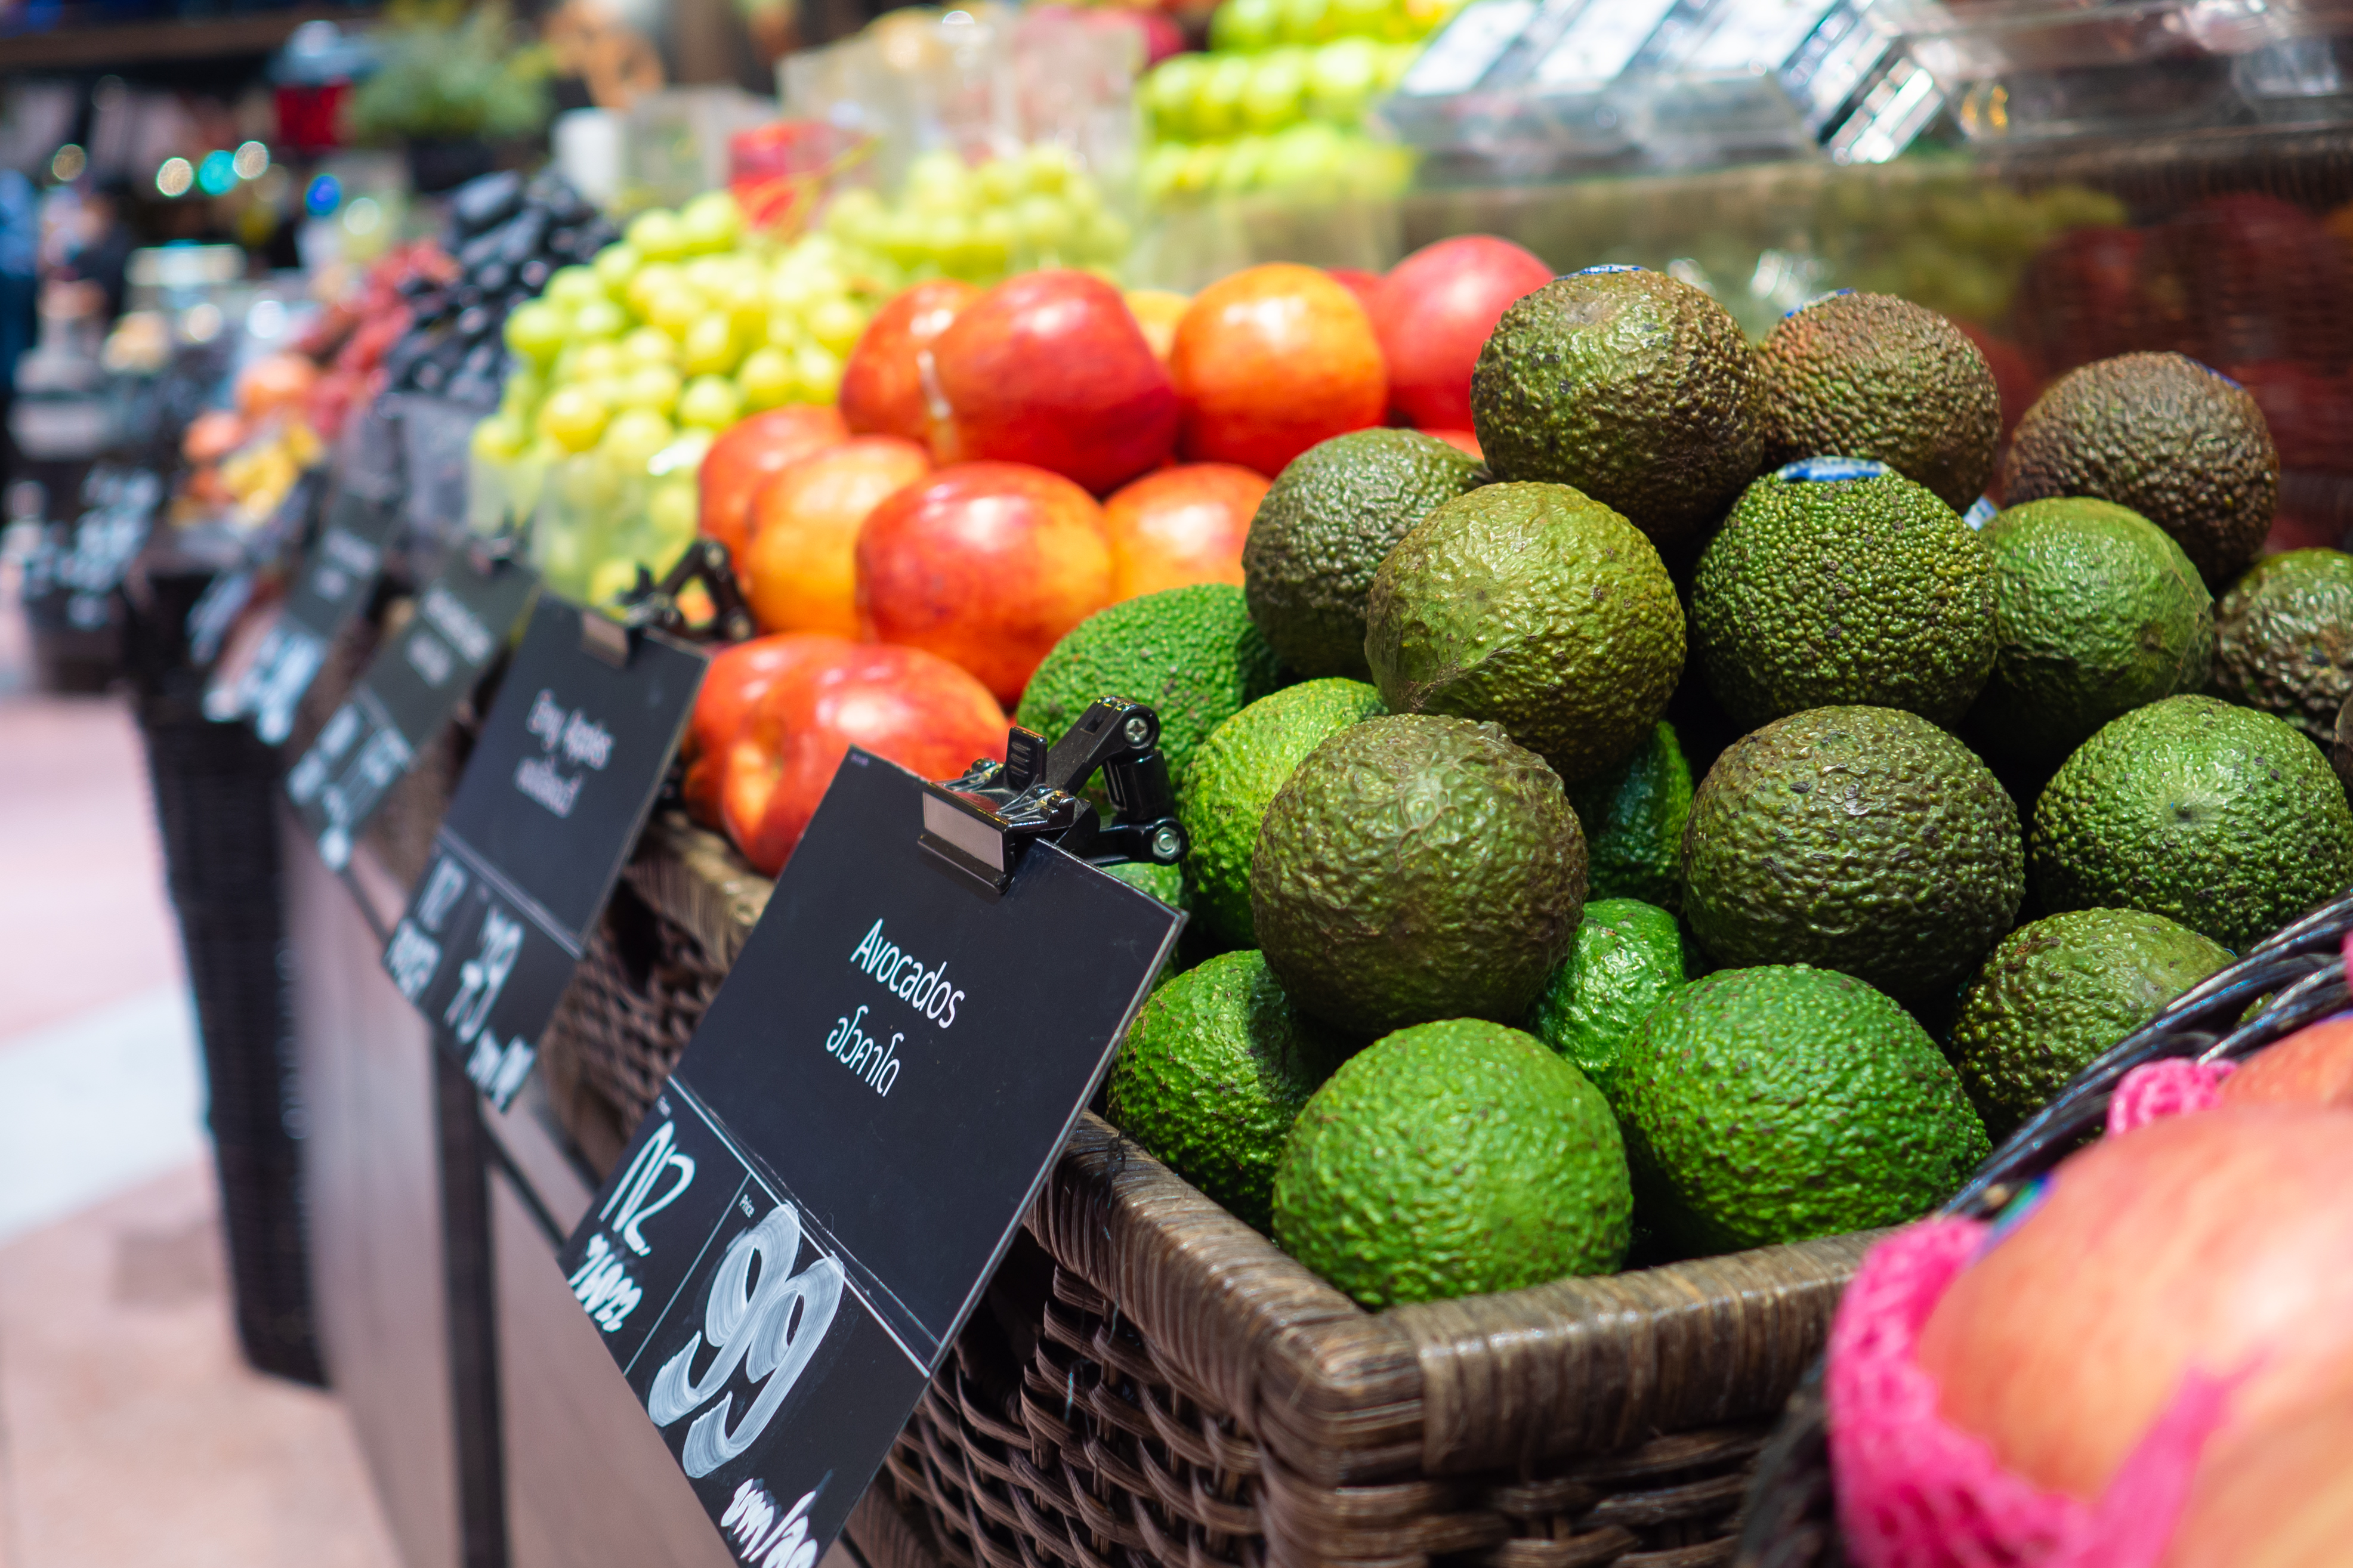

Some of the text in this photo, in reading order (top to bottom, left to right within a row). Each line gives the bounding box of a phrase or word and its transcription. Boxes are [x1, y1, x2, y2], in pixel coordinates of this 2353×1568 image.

[850, 918, 965, 1029] Avocados
[826, 1004, 904, 1097] อโวคาโด
[739, 1194, 755, 1218] Price
[648, 1200, 845, 1479] 99
